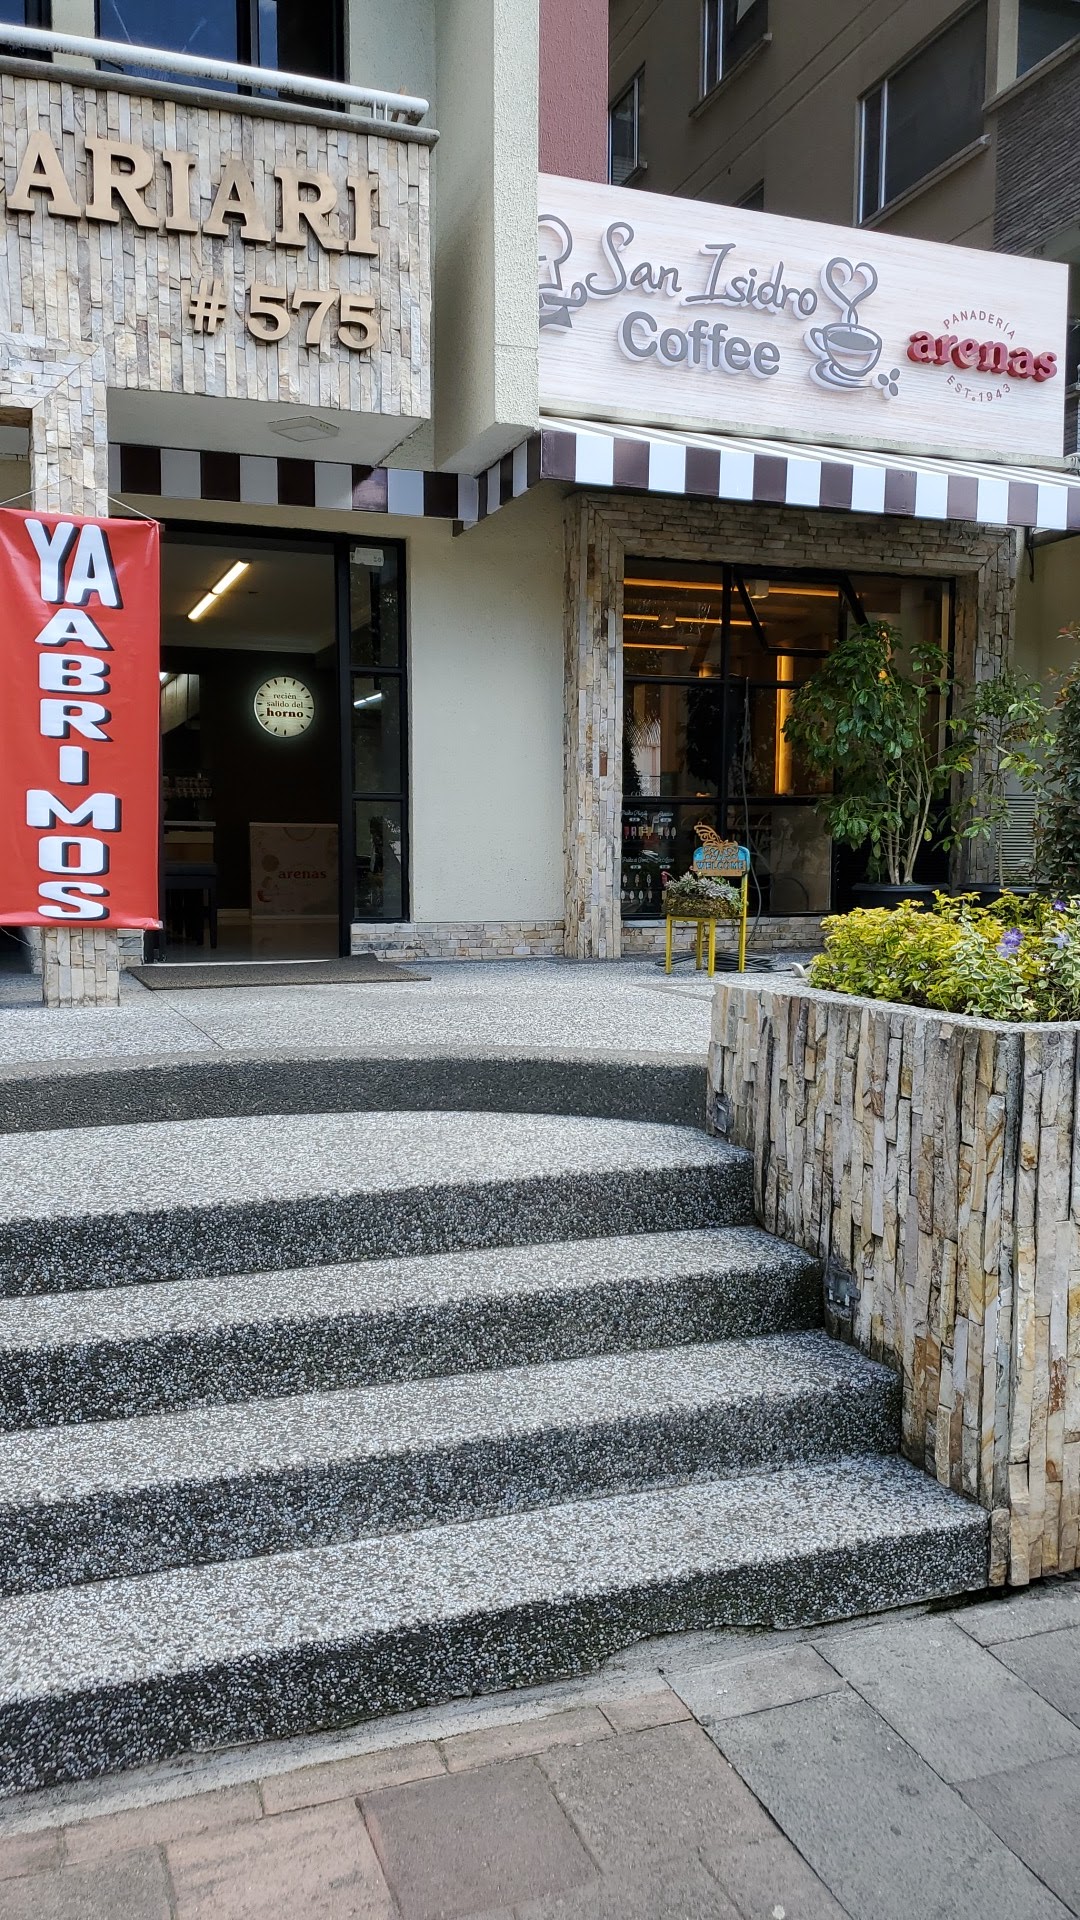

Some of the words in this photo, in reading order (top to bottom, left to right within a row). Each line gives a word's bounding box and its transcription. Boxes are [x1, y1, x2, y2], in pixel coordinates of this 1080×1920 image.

[7, 130, 379, 256] ARIARI
[584, 221, 683, 299] San
[681, 243, 818, 319] Isidro
[617, 311, 781, 378] Coffee
[943, 310, 1016, 340] PANADERÍA
[907, 330, 1058, 382] arenas
[24, 518, 123, 608] YA
[266, 708, 304, 717] horno
[26, 607, 122, 920] ABRIMOS
[278, 870, 328, 879] arenas
[696, 861, 744, 870] WELCOME
